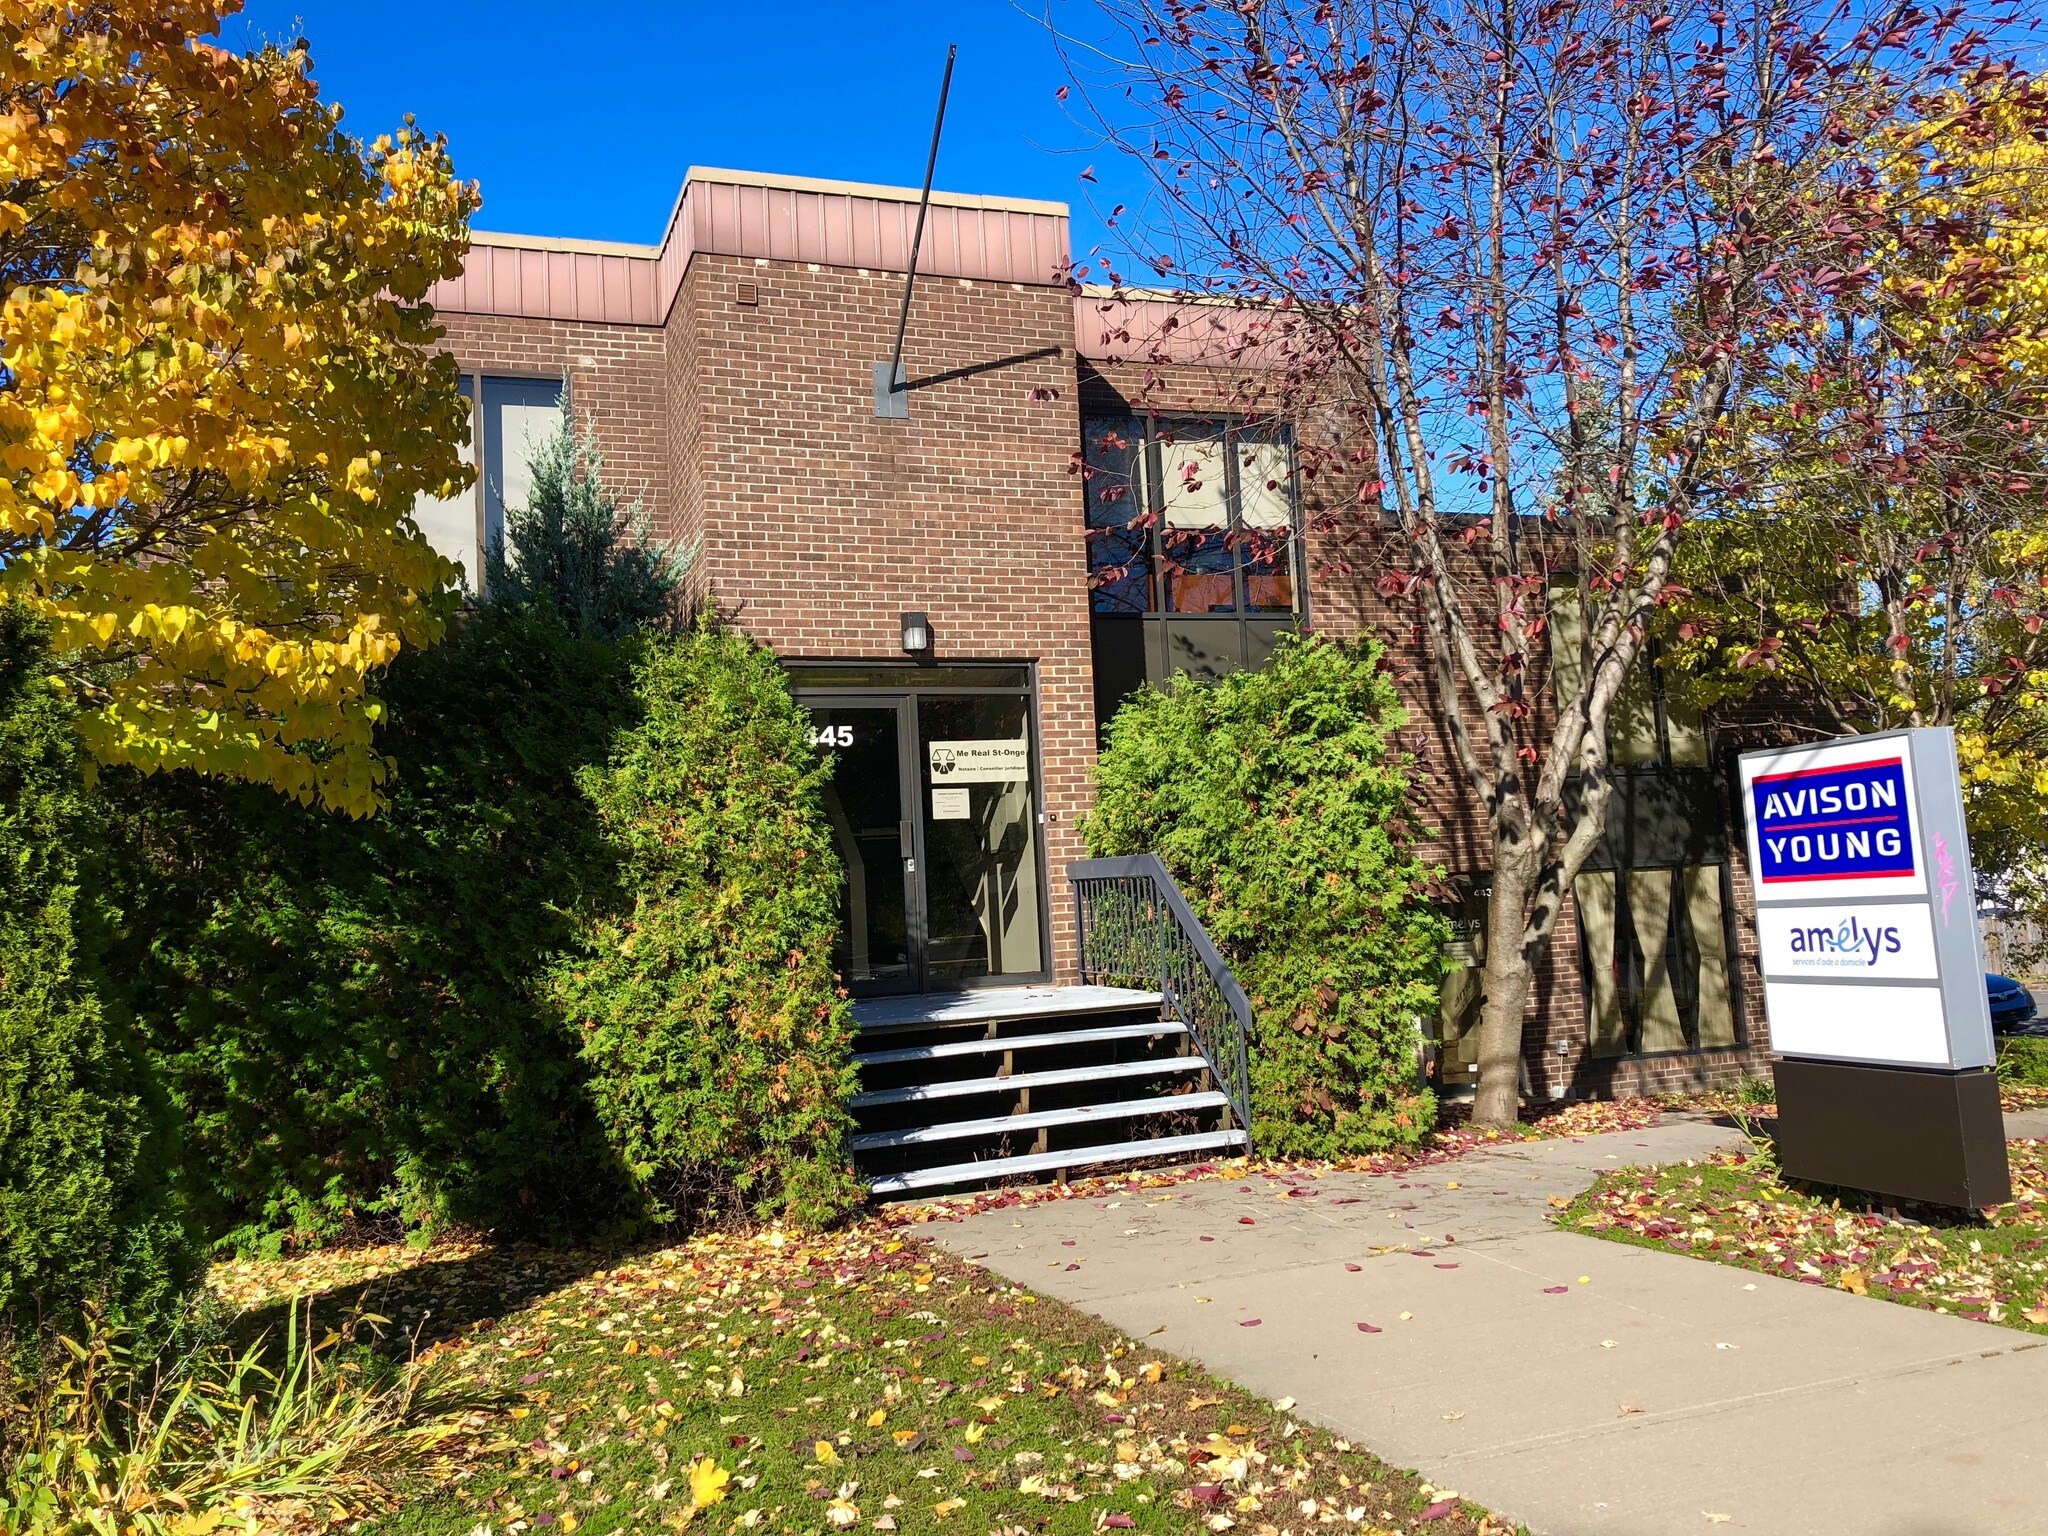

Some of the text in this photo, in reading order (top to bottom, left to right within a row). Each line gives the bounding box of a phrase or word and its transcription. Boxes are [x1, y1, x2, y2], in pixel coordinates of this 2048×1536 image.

[971, 749, 990, 757] Réal
[992, 749, 1025, 758] St-Onge
[1763, 779, 1897, 820] AVISON
[1766, 828, 1902, 864] YOUNG
[1790, 915, 1902, 966] amélys
[1792, 958, 1816, 966] services
[1840, 957, 1866, 967] domicile
